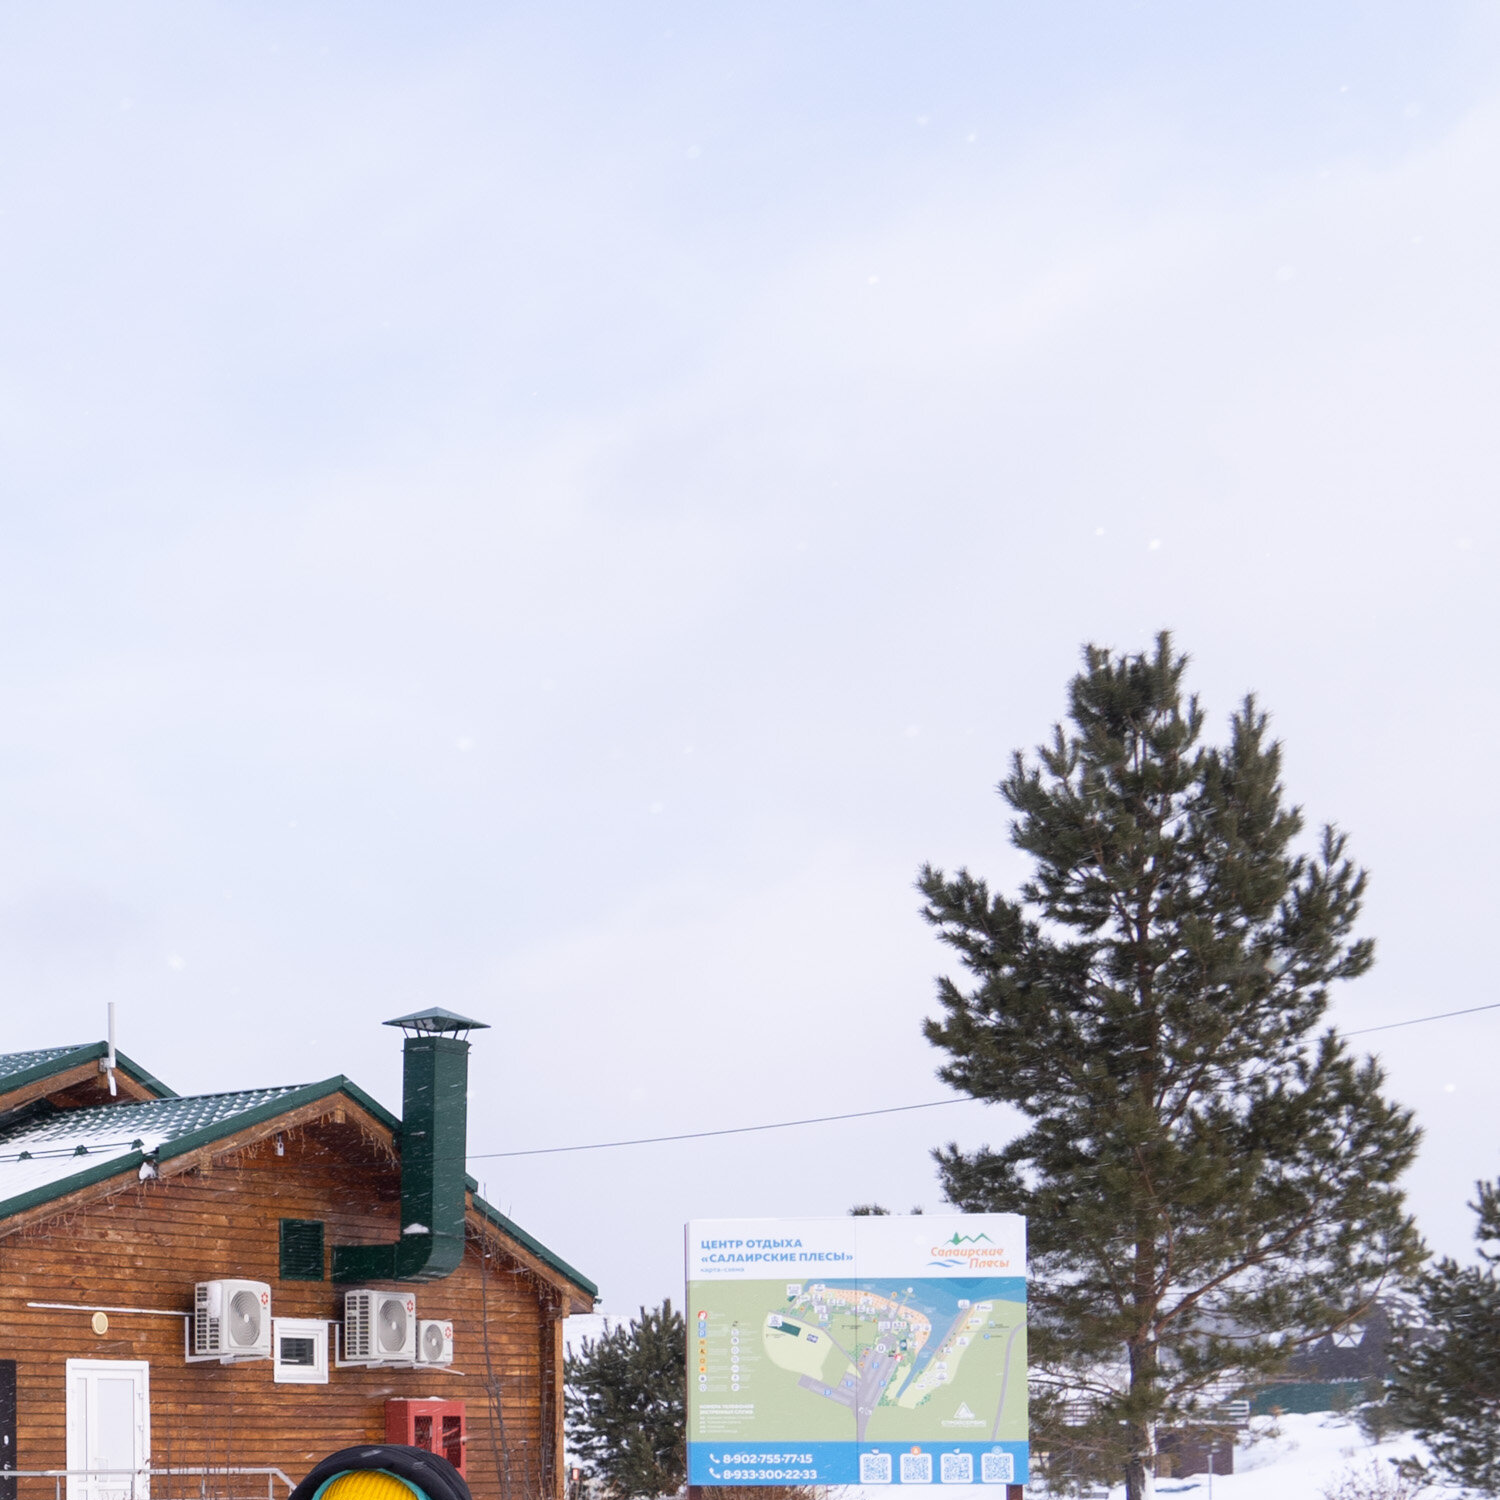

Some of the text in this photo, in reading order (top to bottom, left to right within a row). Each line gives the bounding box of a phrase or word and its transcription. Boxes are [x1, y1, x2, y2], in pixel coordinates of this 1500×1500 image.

[701, 1239, 803, 1250] ЦЕНТР ОТДЫХА
[701, 1252, 853, 1263] «САЛАИРСКИЕ ПЛЕСЫ»
[930, 1247, 1004, 1258] Салаирские
[969, 1258, 1010, 1269] Плесы
